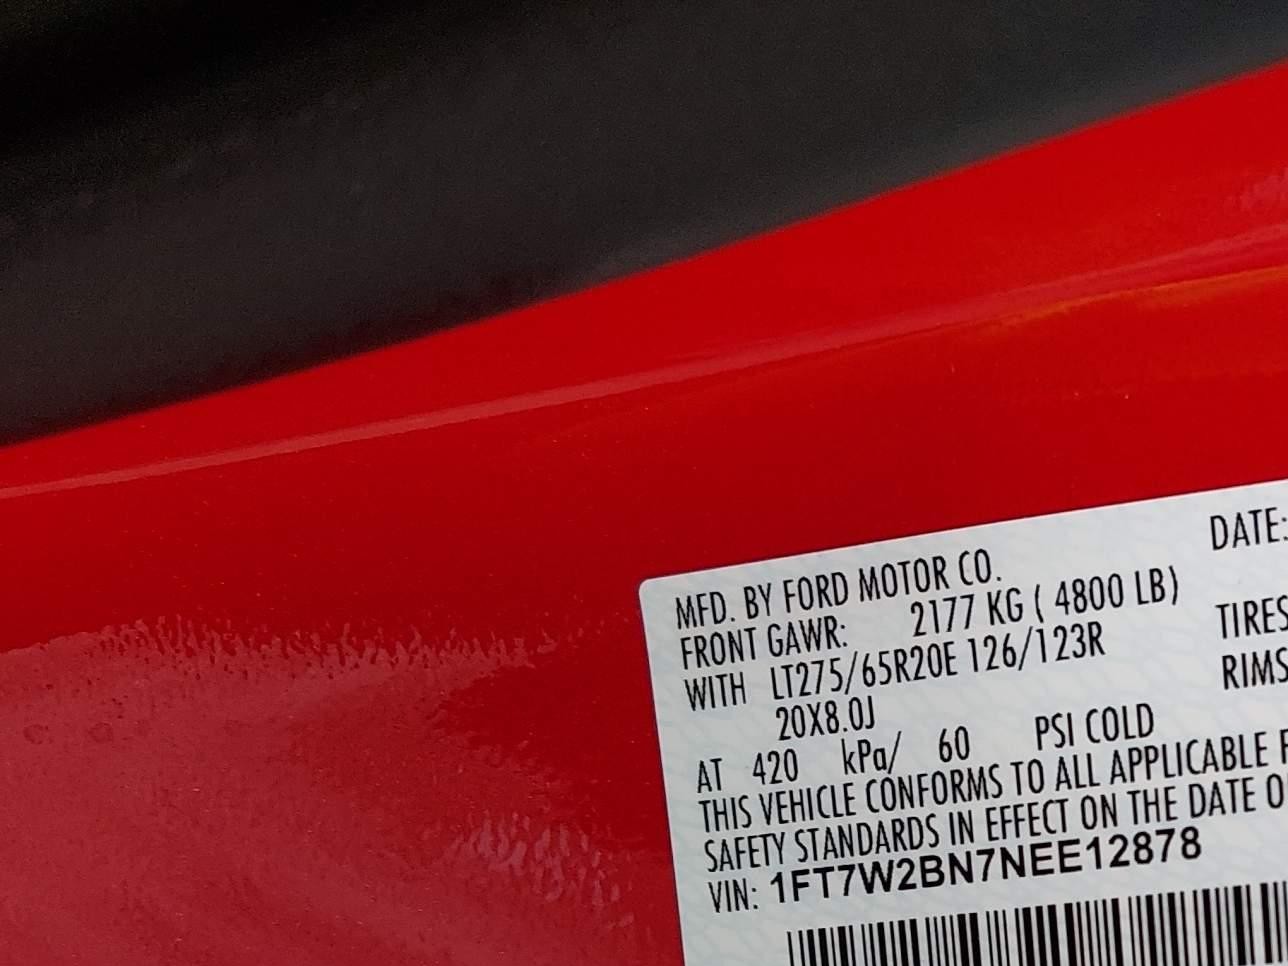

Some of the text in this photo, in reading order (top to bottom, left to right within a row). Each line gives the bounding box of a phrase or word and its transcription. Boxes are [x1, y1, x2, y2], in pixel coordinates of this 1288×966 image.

[1209, 506, 1288, 551] DATE:
[675, 548, 1002, 630] MFD. BY FORD MOTOR CO.
[679, 626, 757, 671] FRONT
[766, 614, 848, 658] GAWR:
[910, 593, 975, 638] 2177
[986, 587, 1024, 626] KG
[1134, 565, 1179, 606] LB)
[683, 671, 747, 712] WITH
[769, 640, 959, 701] LT275/65R20E
[967, 620, 1106, 673] 126/123R
[696, 702, 1155, 794] AT 420 kPa/ 60 PSI COLD
[775, 695, 876, 742] 20X8.0J
[697, 794, 753, 834] THIS
[758, 781, 857, 826] VEHICLE
[865, 763, 1004, 814] CONFORMS
[1009, 758, 1045, 797] TO
[1055, 752, 1101, 792] ALL
[1109, 731, 1269, 786] APPLICABLE
[703, 831, 786, 873] SAFETY
[794, 812, 940, 863] STANDARDS
[948, 809, 975, 847] IN
[984, 797, 1069, 842] EFFECT
[1080, 792, 1119, 831] ON
[1126, 785, 1179, 826] THE
[1188, 776, 1257, 820] DATE
[707, 877, 759, 914] VIN:
[769, 825, 1202, 904] 1FT7W2BN7NEE12878
